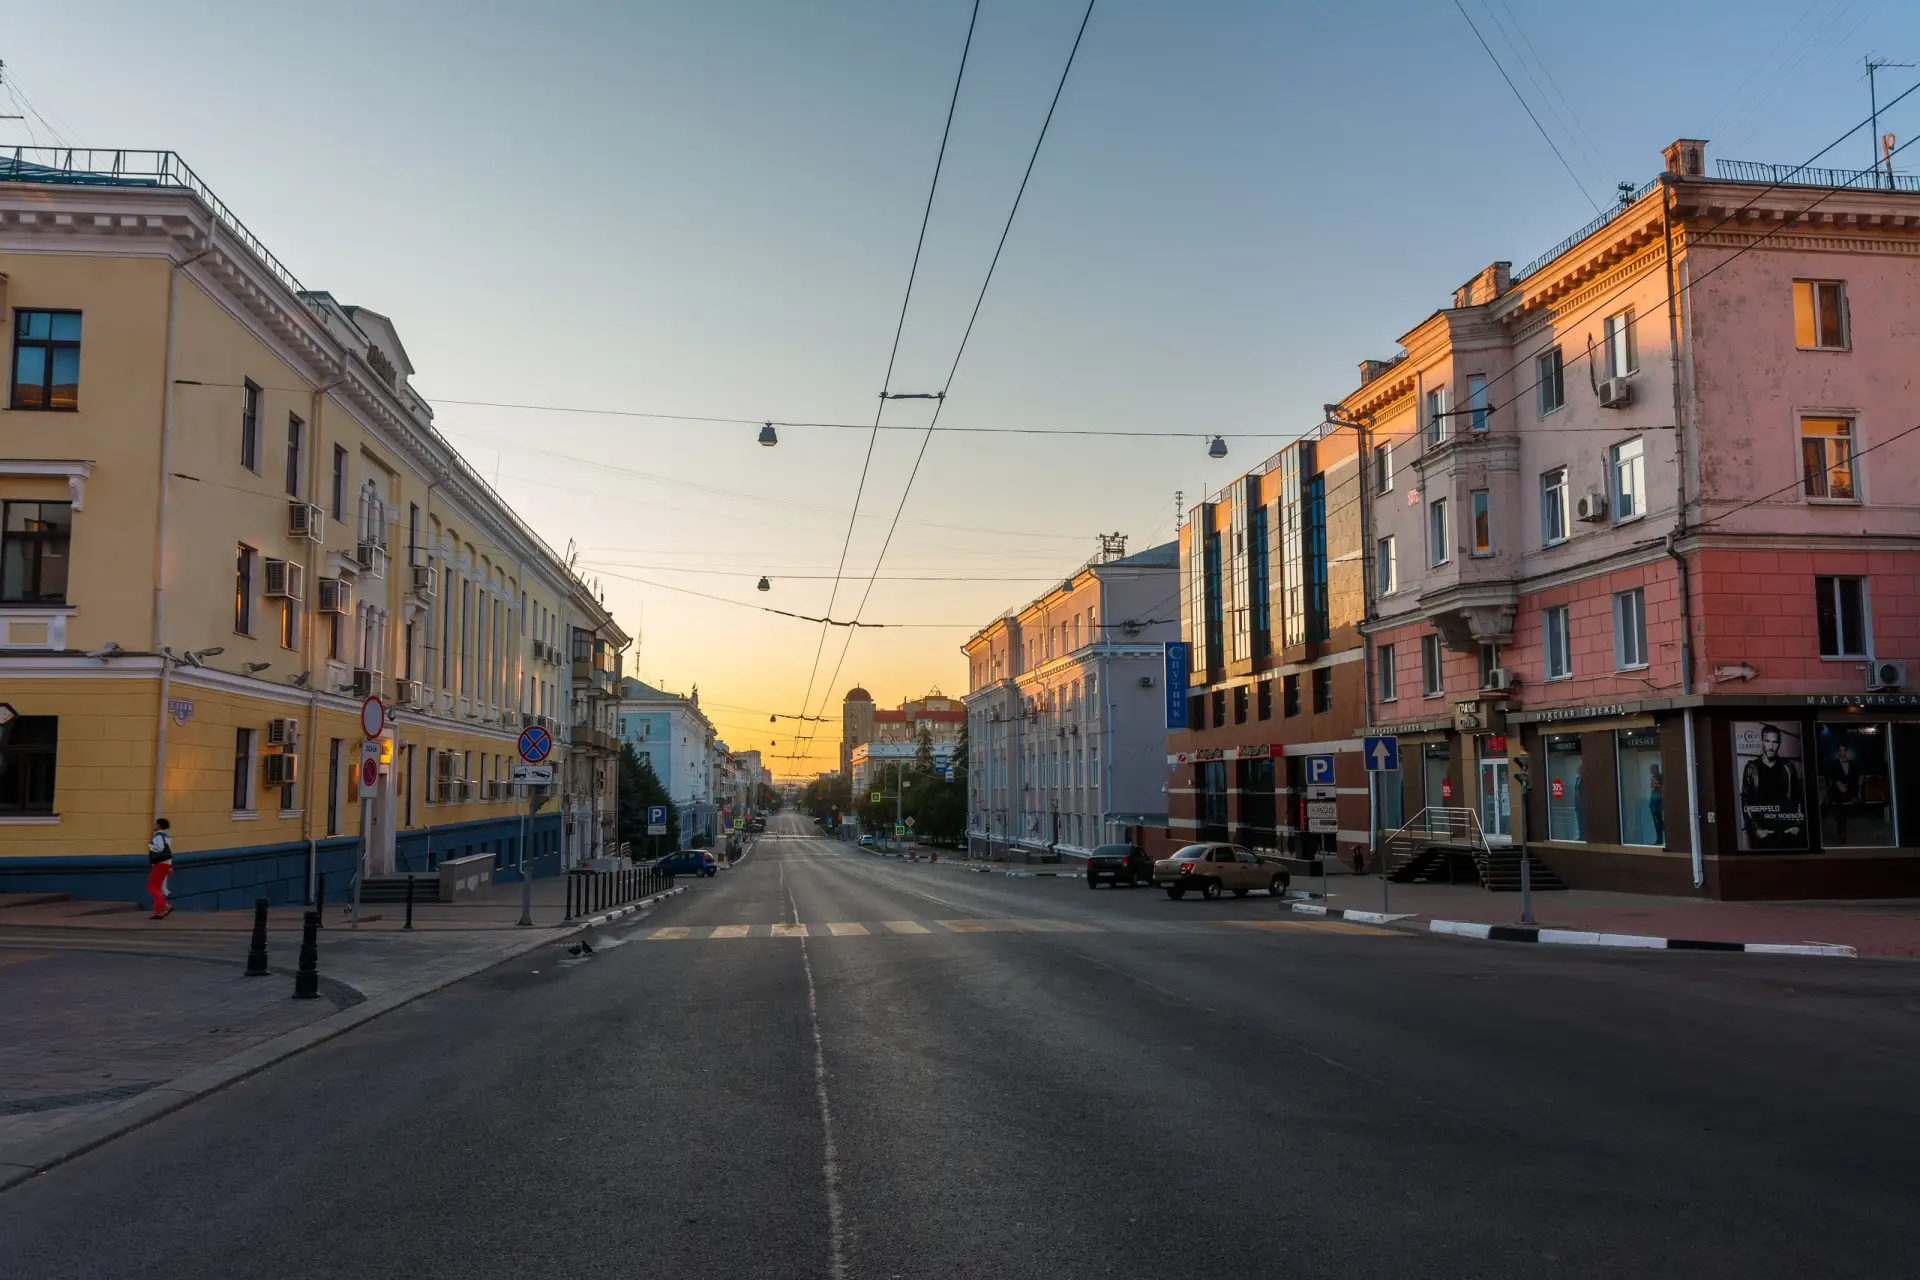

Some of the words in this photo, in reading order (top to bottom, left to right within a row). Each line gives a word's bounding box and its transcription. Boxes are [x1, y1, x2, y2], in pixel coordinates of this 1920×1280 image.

[1806, 695, 1918, 704] МАГАЗИН-СА
[1536, 709, 1575, 720] МУЖСКАЯ
[1585, 705, 1622, 716] ОДЕЖДА
